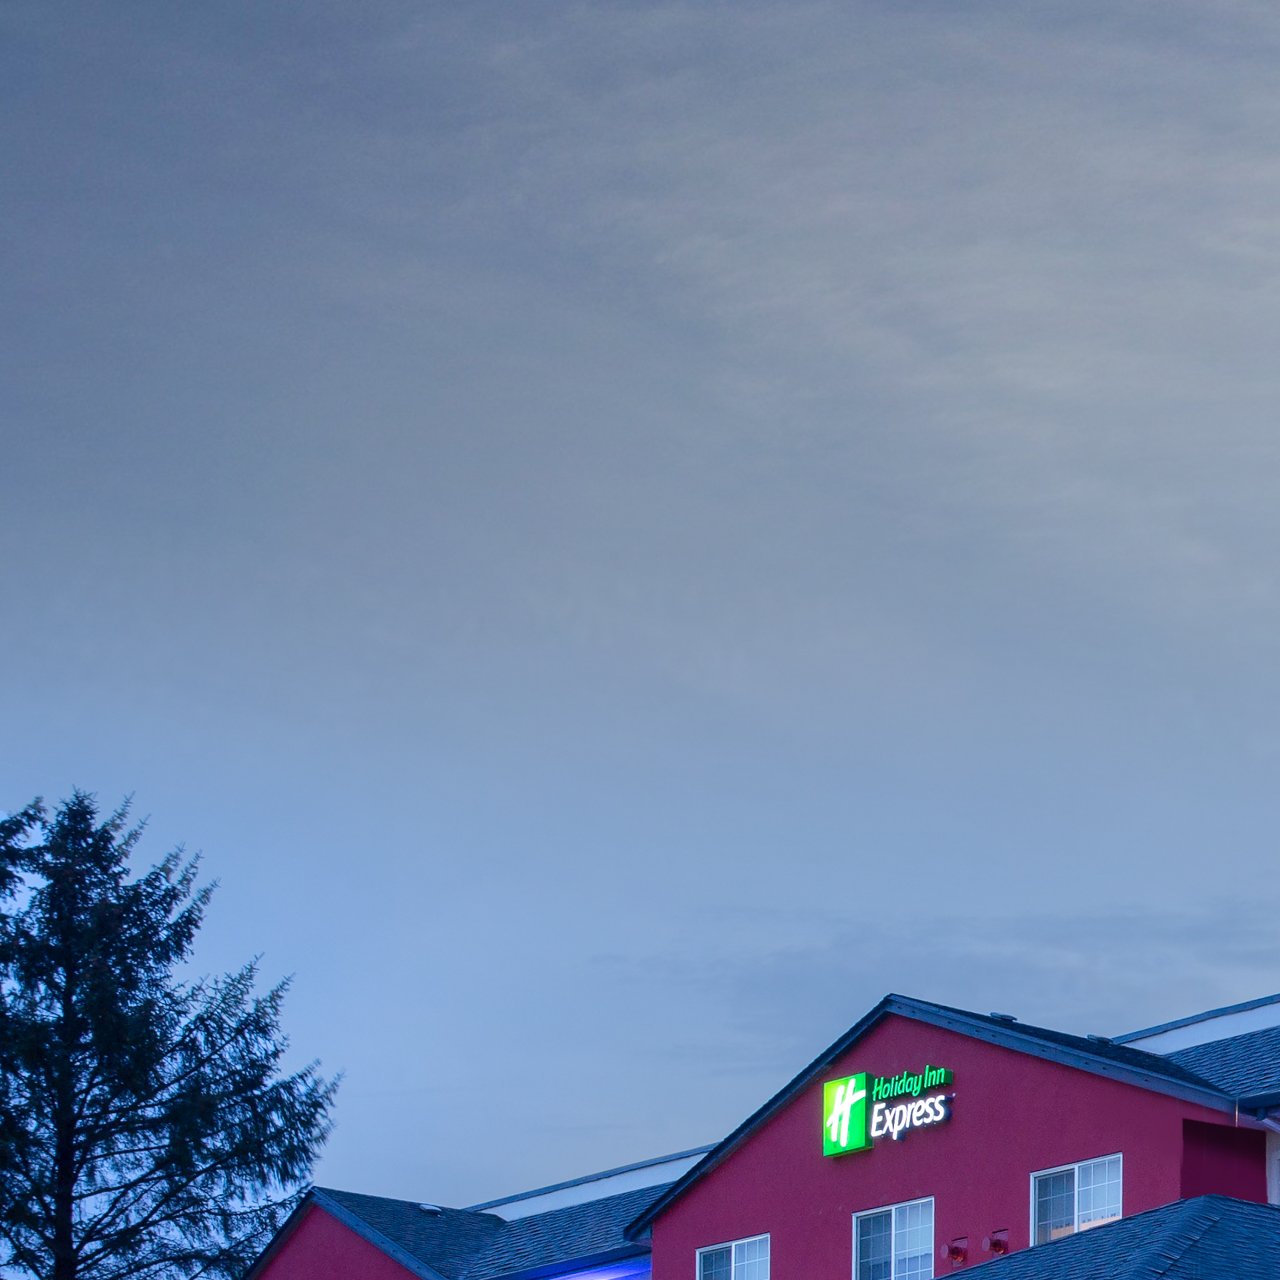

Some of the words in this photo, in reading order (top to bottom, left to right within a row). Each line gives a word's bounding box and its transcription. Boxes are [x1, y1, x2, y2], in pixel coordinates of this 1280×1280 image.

[872, 1070, 922, 1101] Holiday
[923, 1064, 946, 1088] Inn
[870, 1094, 946, 1141] Express
